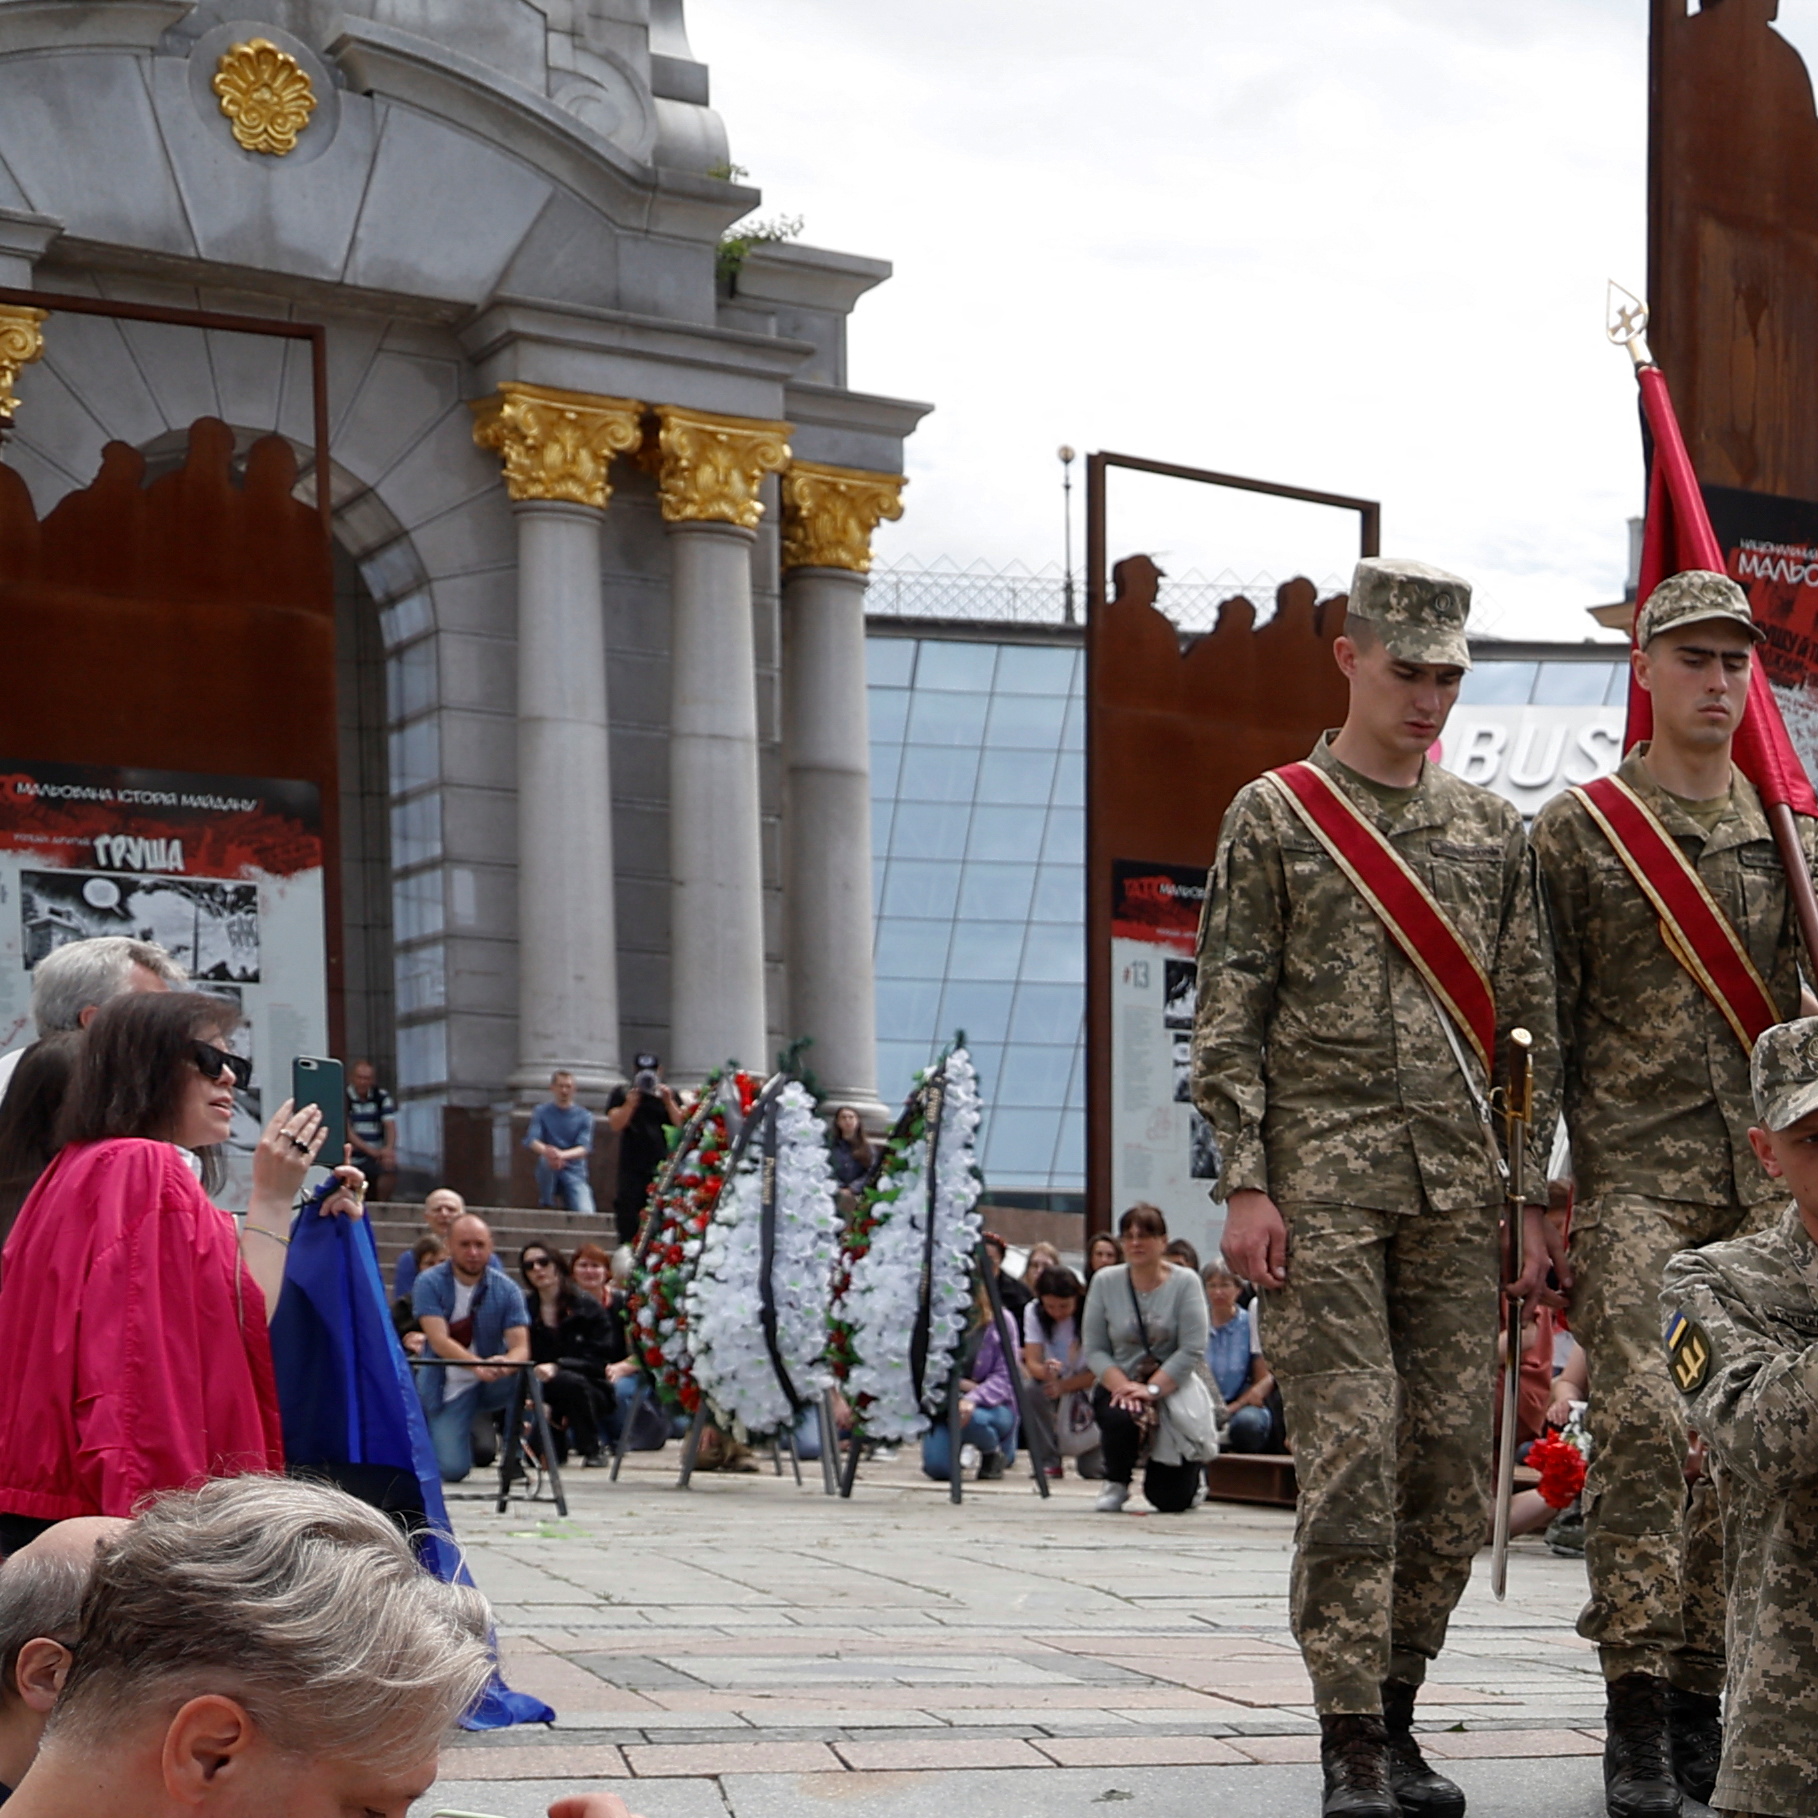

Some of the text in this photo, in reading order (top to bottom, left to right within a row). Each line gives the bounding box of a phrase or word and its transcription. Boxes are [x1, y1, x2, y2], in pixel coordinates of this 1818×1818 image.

[16, 781, 113, 801] МАЛЬОВАНА
[117, 788, 178, 806] ІСТОРІЯ
[181, 793, 258, 811] МАЙДАНУ
[93, 832, 185, 872] ГРУША
